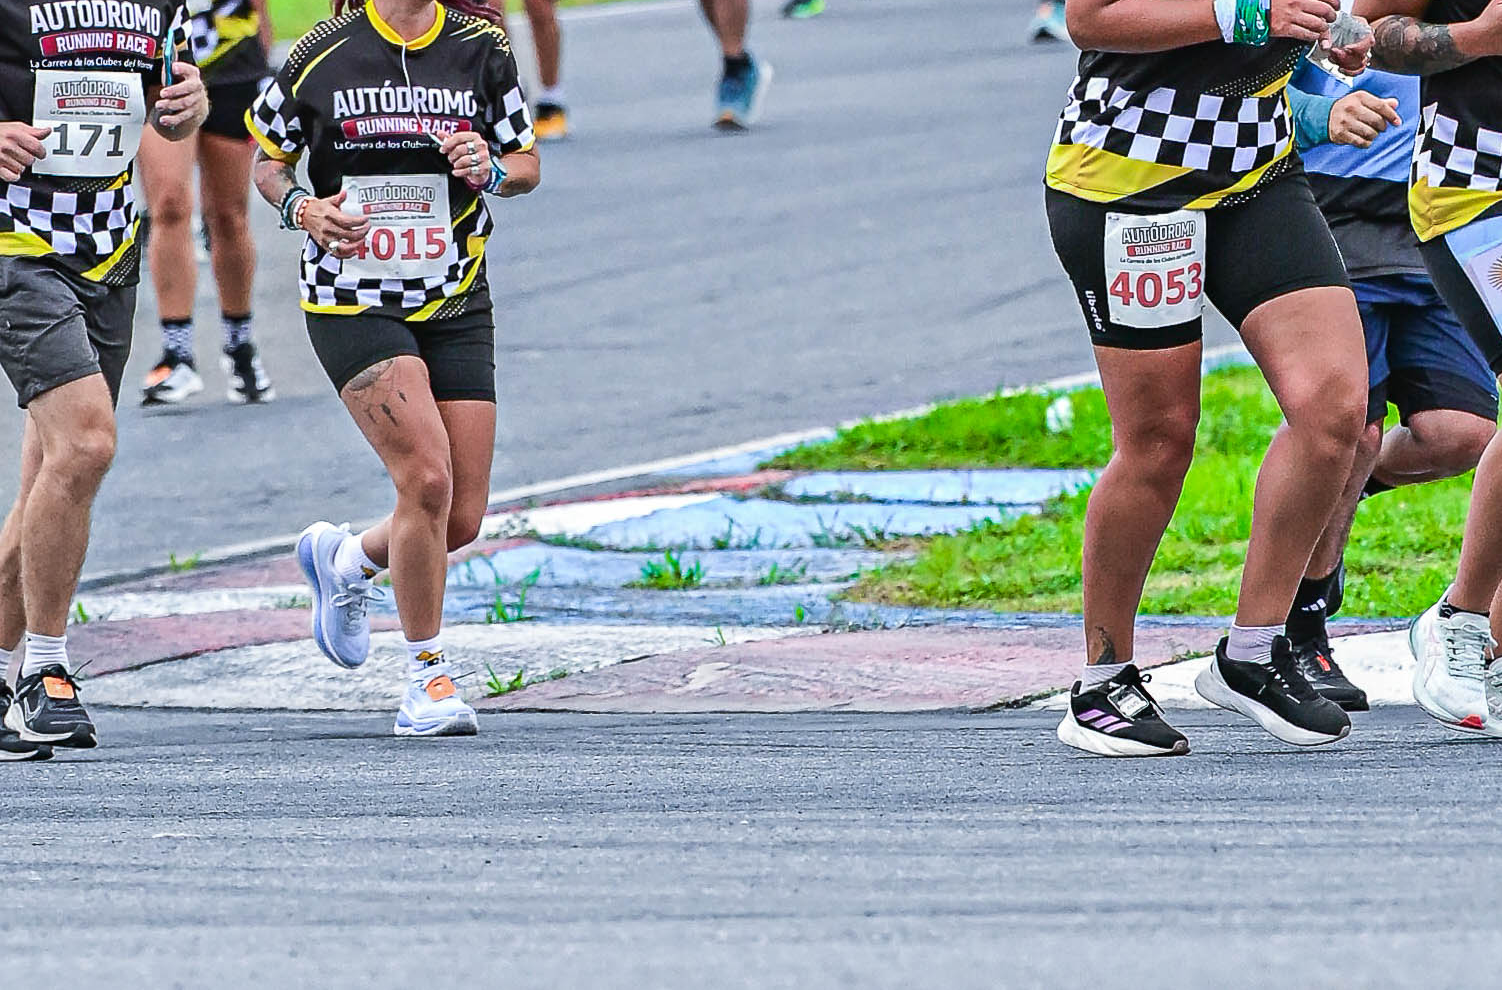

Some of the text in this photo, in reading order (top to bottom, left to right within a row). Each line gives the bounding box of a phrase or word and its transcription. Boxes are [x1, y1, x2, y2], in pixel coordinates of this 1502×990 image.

[55, 30, 148, 54] RUNNING RACE
[30, 60, 40, 68] La
[41, 59, 72, 68] Carrera
[84, 57, 94, 66] los
[53, 76, 129, 98] AUTÓDROMO
[333, 80, 477, 119] AUTÓDROMO
[356, 117, 459, 136] RUNNING RACE
[52, 123, 123, 156] 171
[334, 141, 343, 149] La
[375, 140, 385, 149] de
[387, 140, 400, 149] los
[359, 181, 435, 203] AUTÓDROMO
[1121, 220, 1196, 244] AUTÓDROMO
[1109, 262, 1202, 308] 4053
